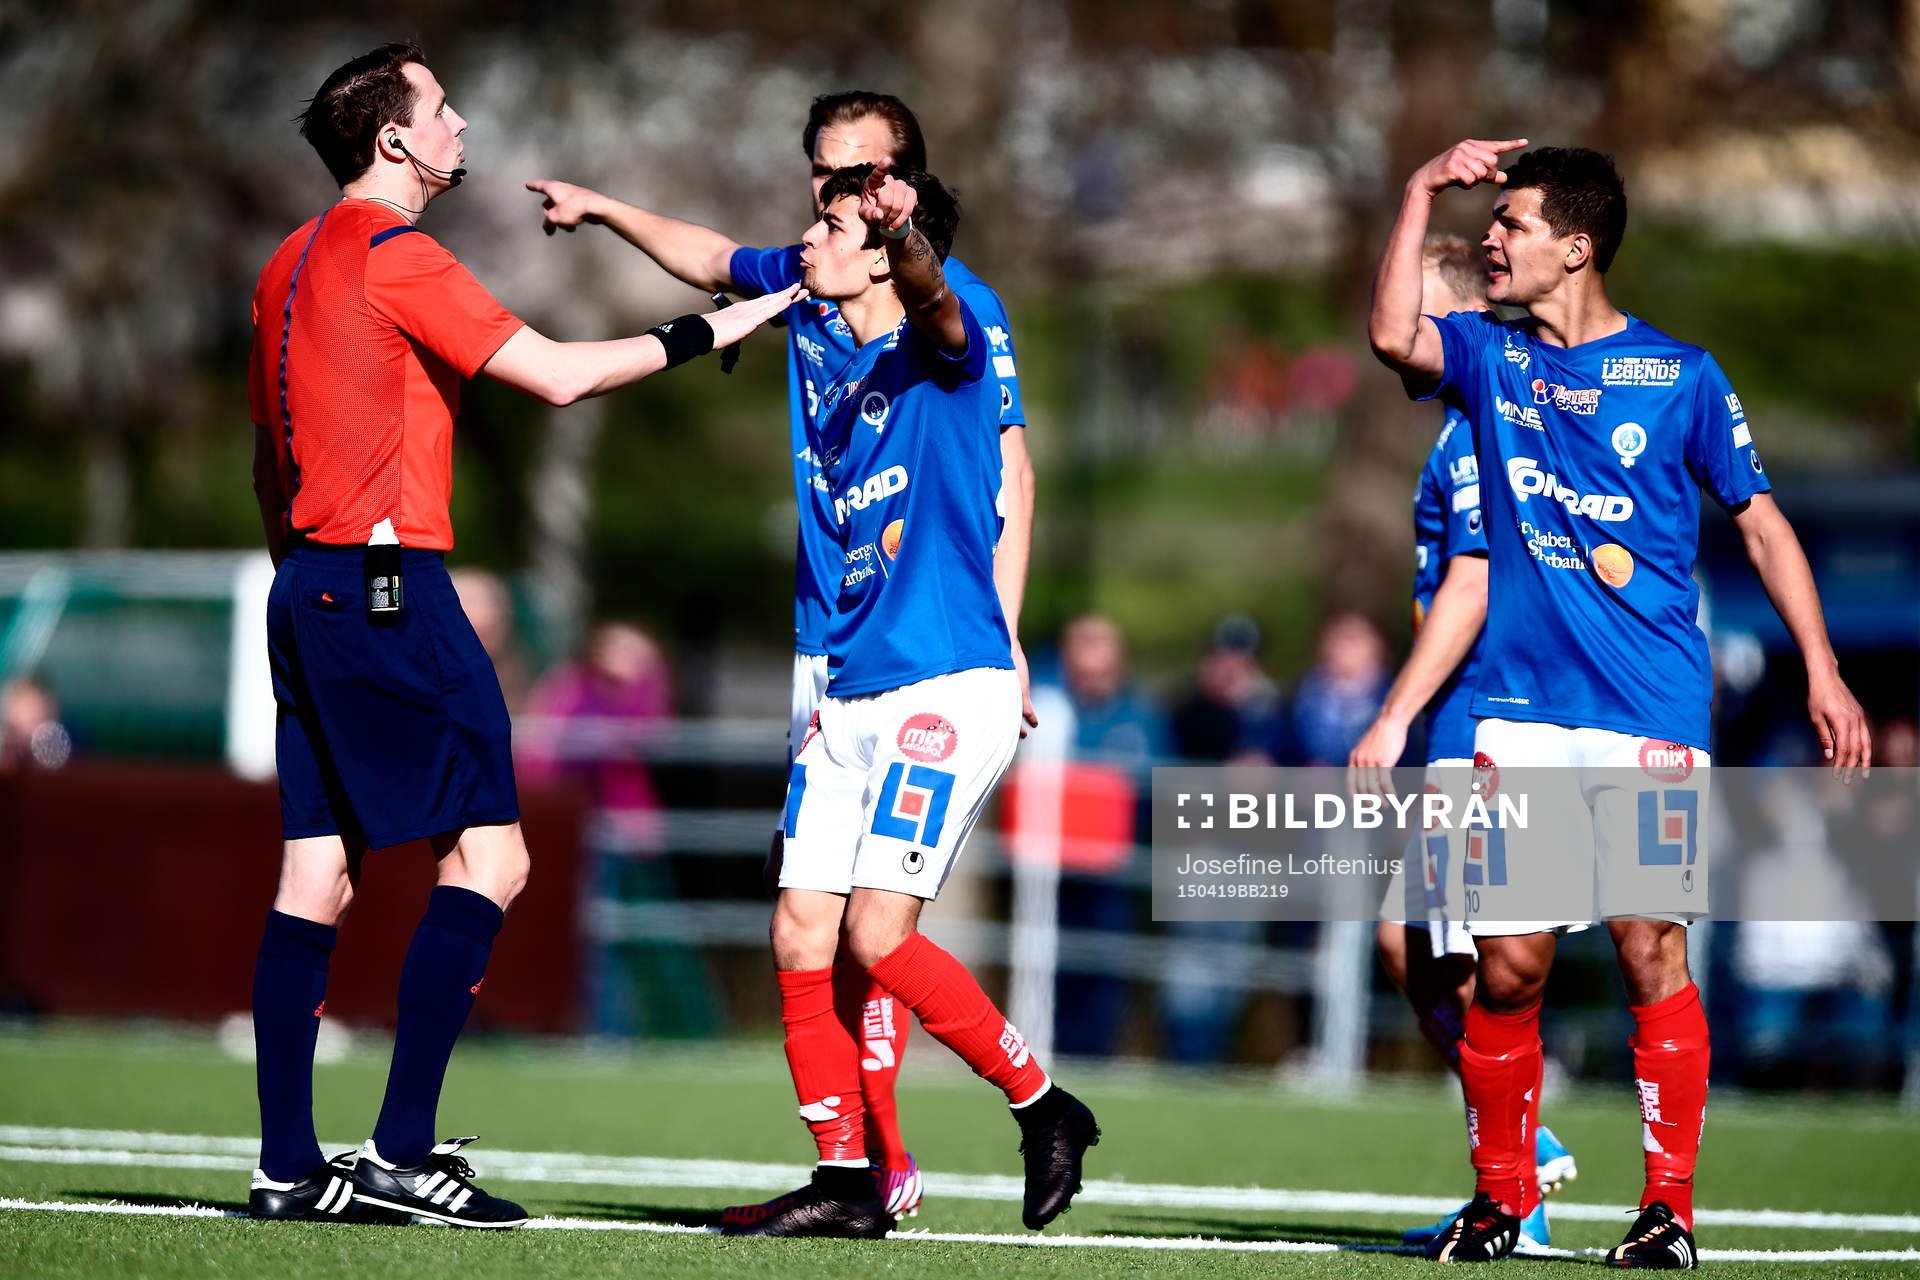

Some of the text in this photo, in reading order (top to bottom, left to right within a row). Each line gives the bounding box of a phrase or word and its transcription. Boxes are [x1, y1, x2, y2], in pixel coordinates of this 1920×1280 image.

[1601, 363, 1681, 380] LEGENDS
[1556, 398, 1598, 415] SPORT
[1506, 457, 1634, 522] CONRAD
[863, 999, 882, 1039] INTER
